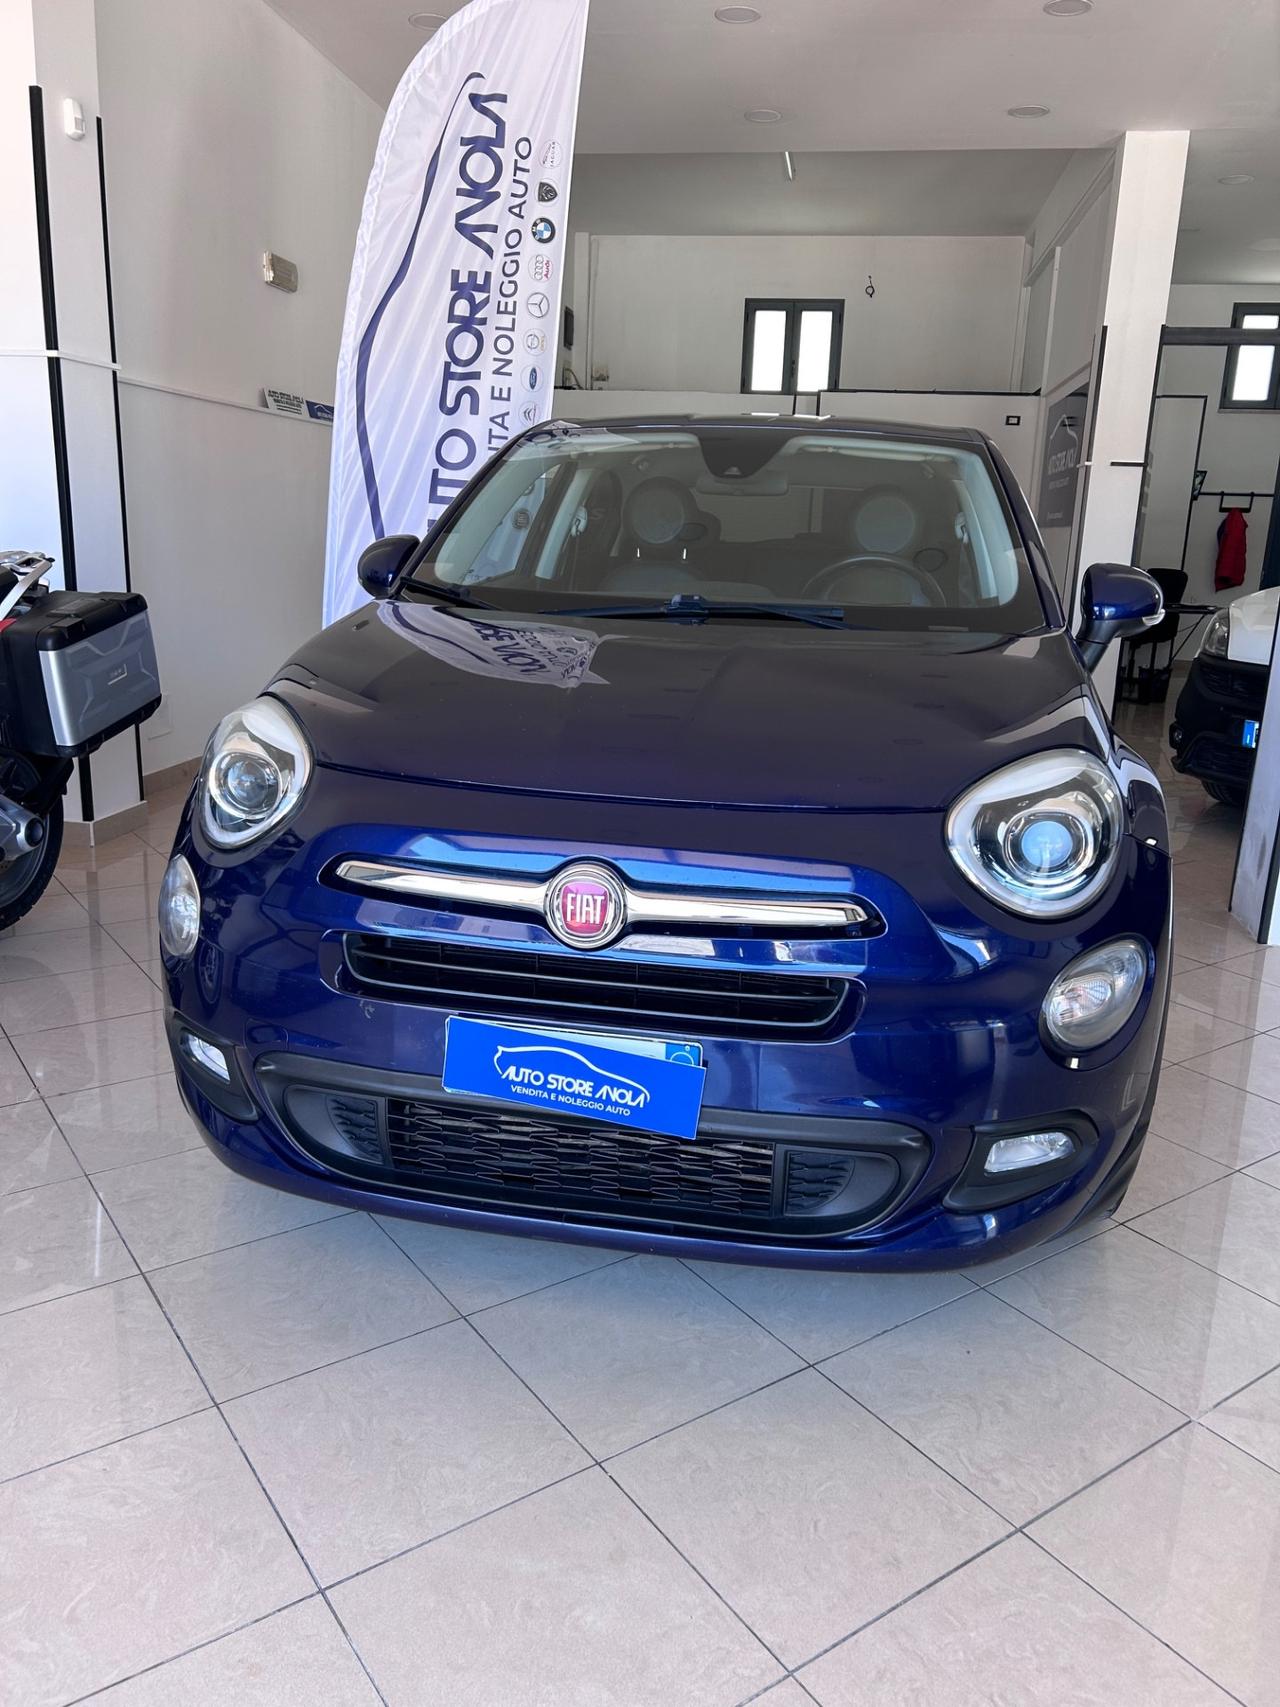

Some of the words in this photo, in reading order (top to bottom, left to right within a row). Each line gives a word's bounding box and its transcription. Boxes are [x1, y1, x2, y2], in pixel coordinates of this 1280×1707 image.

[508, 136, 532, 220] AUTO
[493, 228, 523, 377] NOLEGGIO
[439, 269, 492, 416] STORE
[491, 386, 511, 402] E
[566, 893, 605, 925] FIAT
[501, 1065, 544, 1086] AUTO
[547, 1073, 594, 1097] STORE
[511, 1084, 549, 1100] VENDITA
[550, 1092, 557, 1101] E
[558, 1094, 605, 1111] NOLEGGIO
[605, 1105, 631, 1117] AUTO
